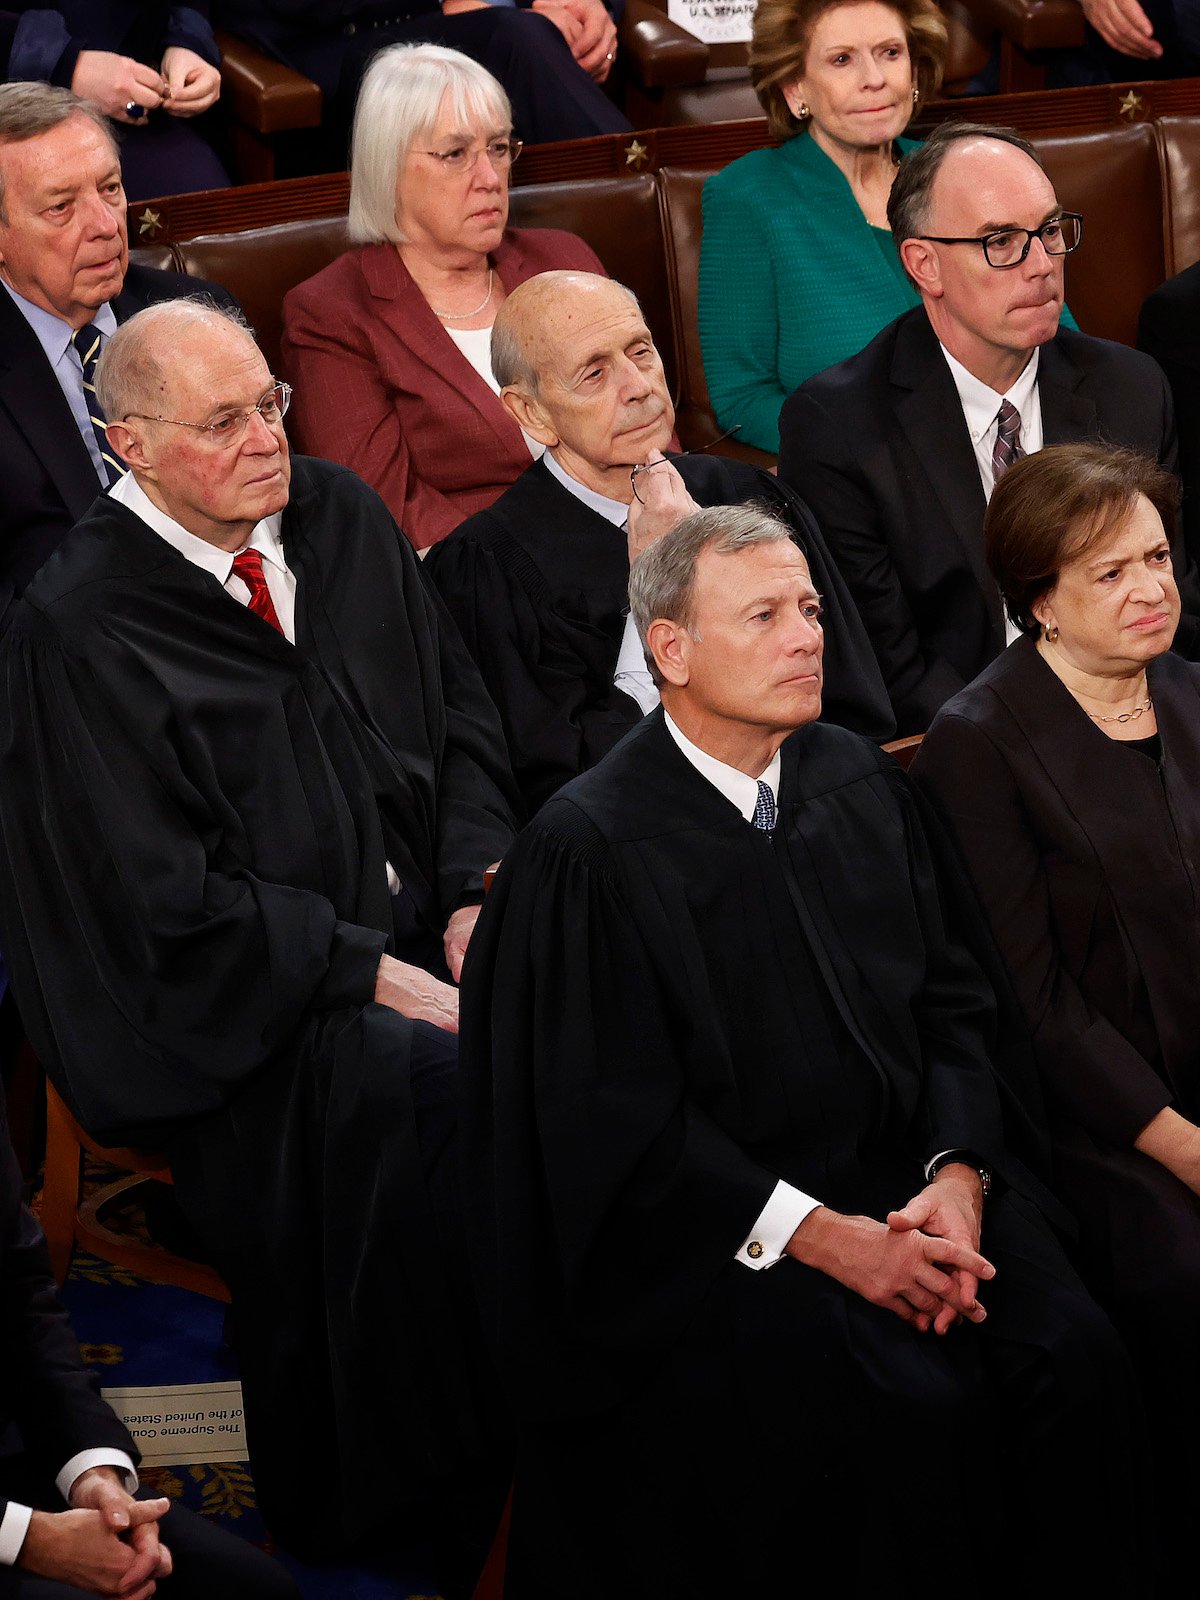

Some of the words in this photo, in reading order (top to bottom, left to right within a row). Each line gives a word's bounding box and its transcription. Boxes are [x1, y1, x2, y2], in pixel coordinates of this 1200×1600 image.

[165, 1412, 205, 1422] United
[208, 1410, 227, 1419] the
[230, 1409, 243, 1417] of
[123, 1414, 162, 1424] States
[160, 1425, 215, 1436] Supreme
[219, 1424, 241, 1433] The
